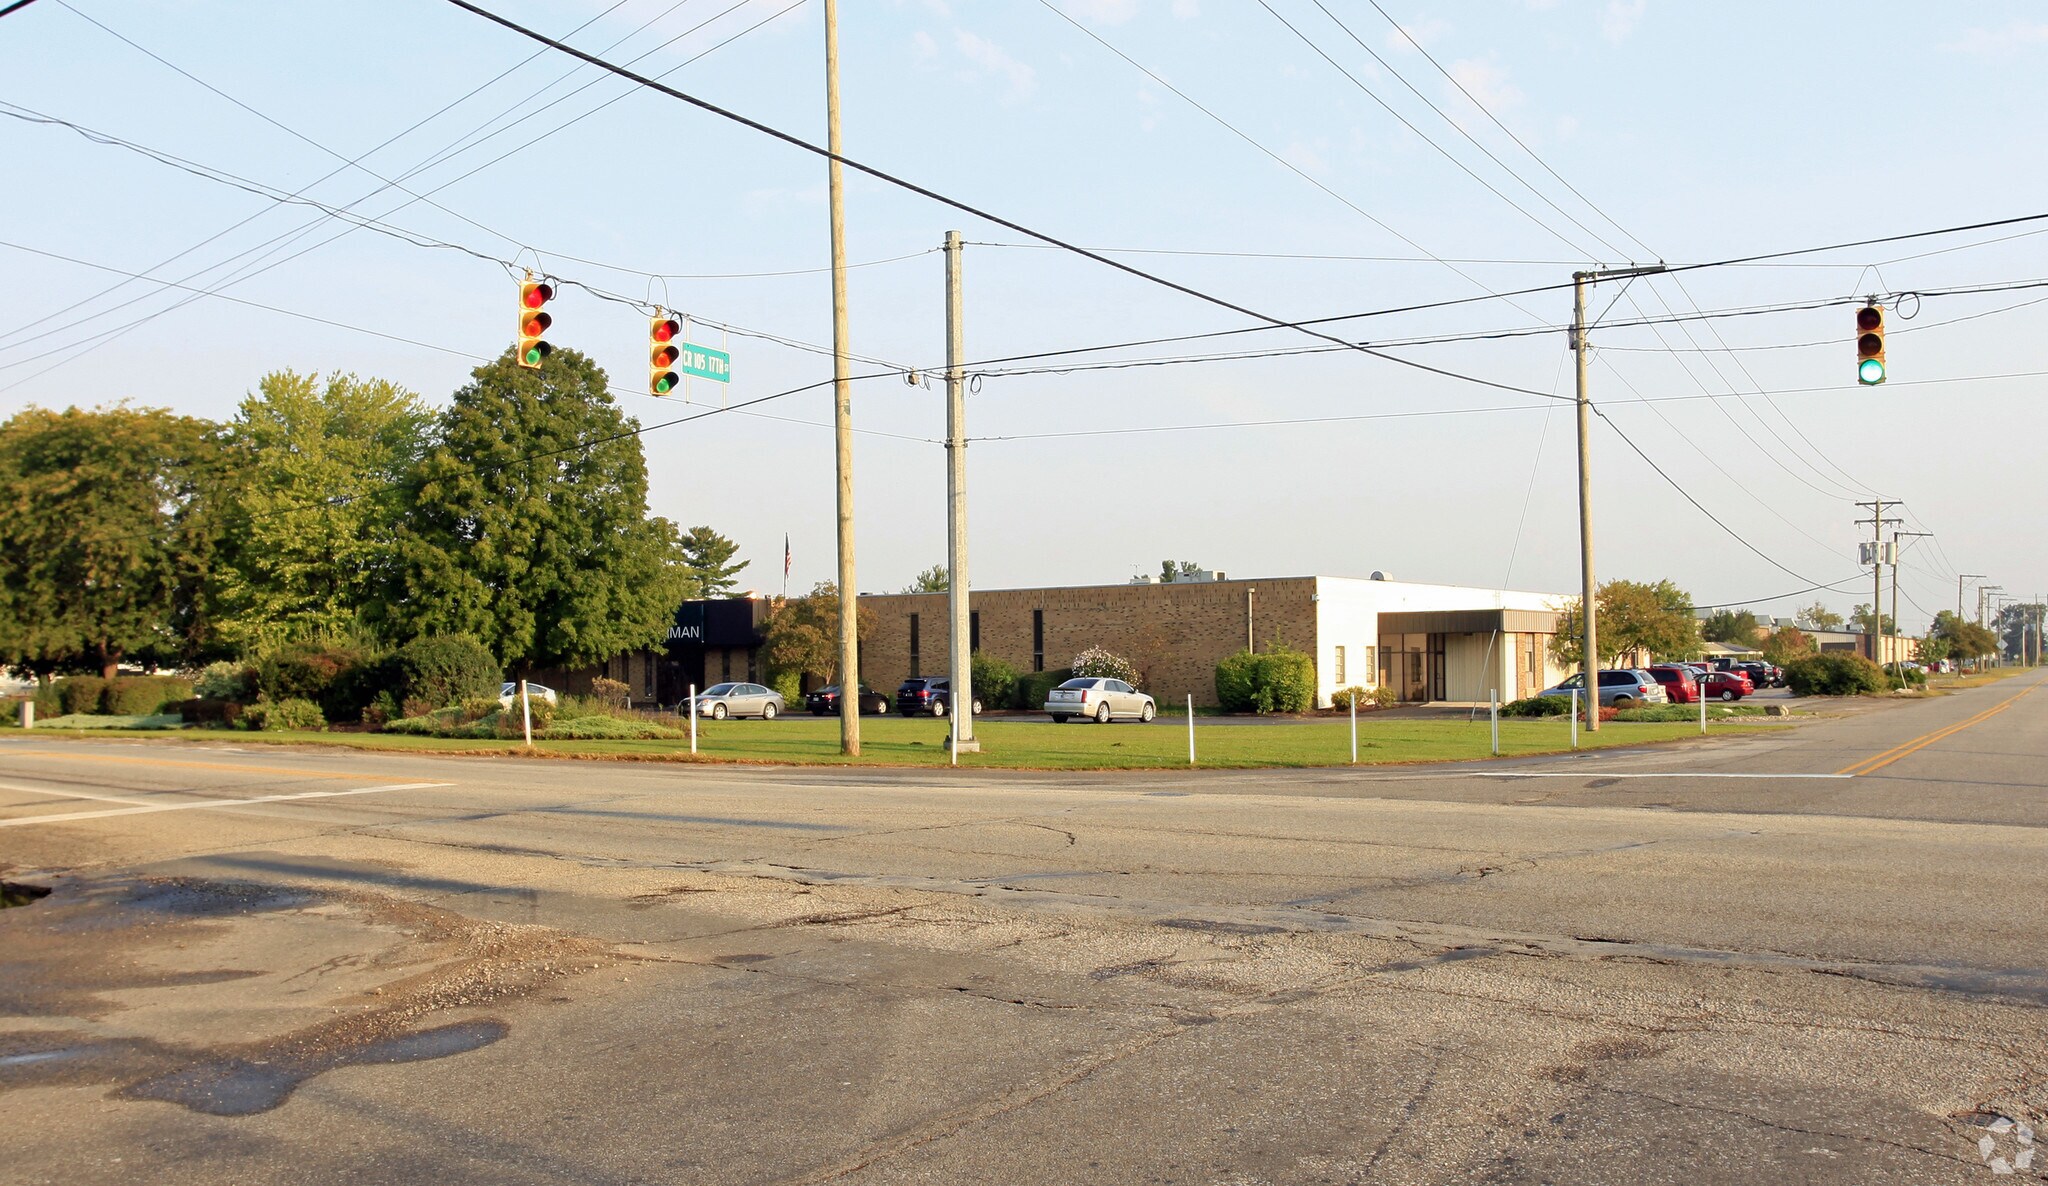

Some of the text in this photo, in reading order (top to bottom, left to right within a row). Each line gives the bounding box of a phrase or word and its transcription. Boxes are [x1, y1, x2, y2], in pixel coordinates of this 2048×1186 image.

[683, 350, 693, 368] CR
[694, 352, 706, 371] 105
[708, 355, 724, 375] 17TH
[667, 626, 700, 639] MAN
